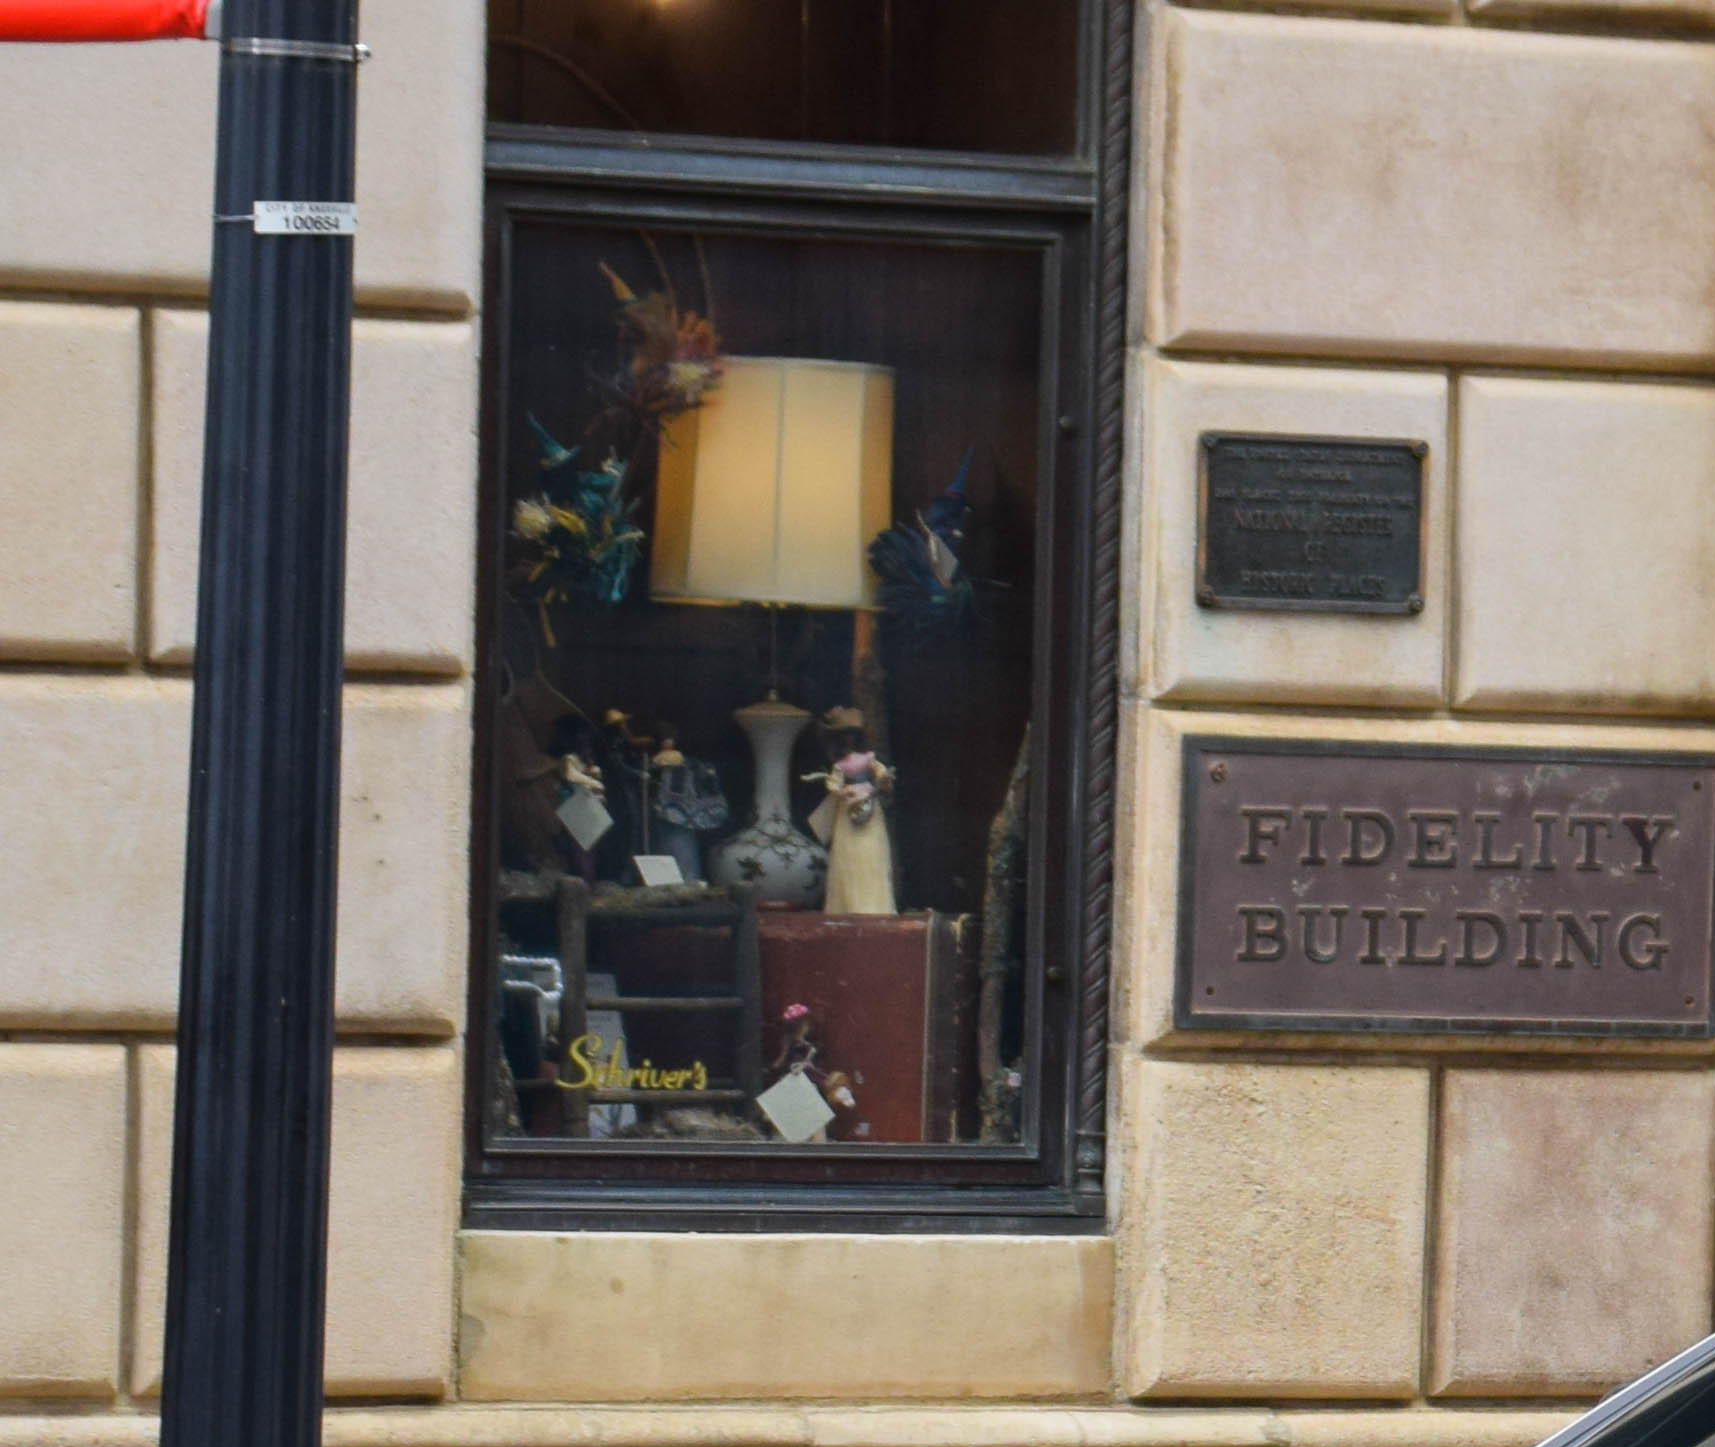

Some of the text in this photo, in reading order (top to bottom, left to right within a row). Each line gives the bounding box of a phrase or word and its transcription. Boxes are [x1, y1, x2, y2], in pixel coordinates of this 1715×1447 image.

[1238, 805, 1676, 873] FIDELITY
[1236, 904, 1672, 971] BUILDING
[555, 1033, 708, 1091] Schriver's
